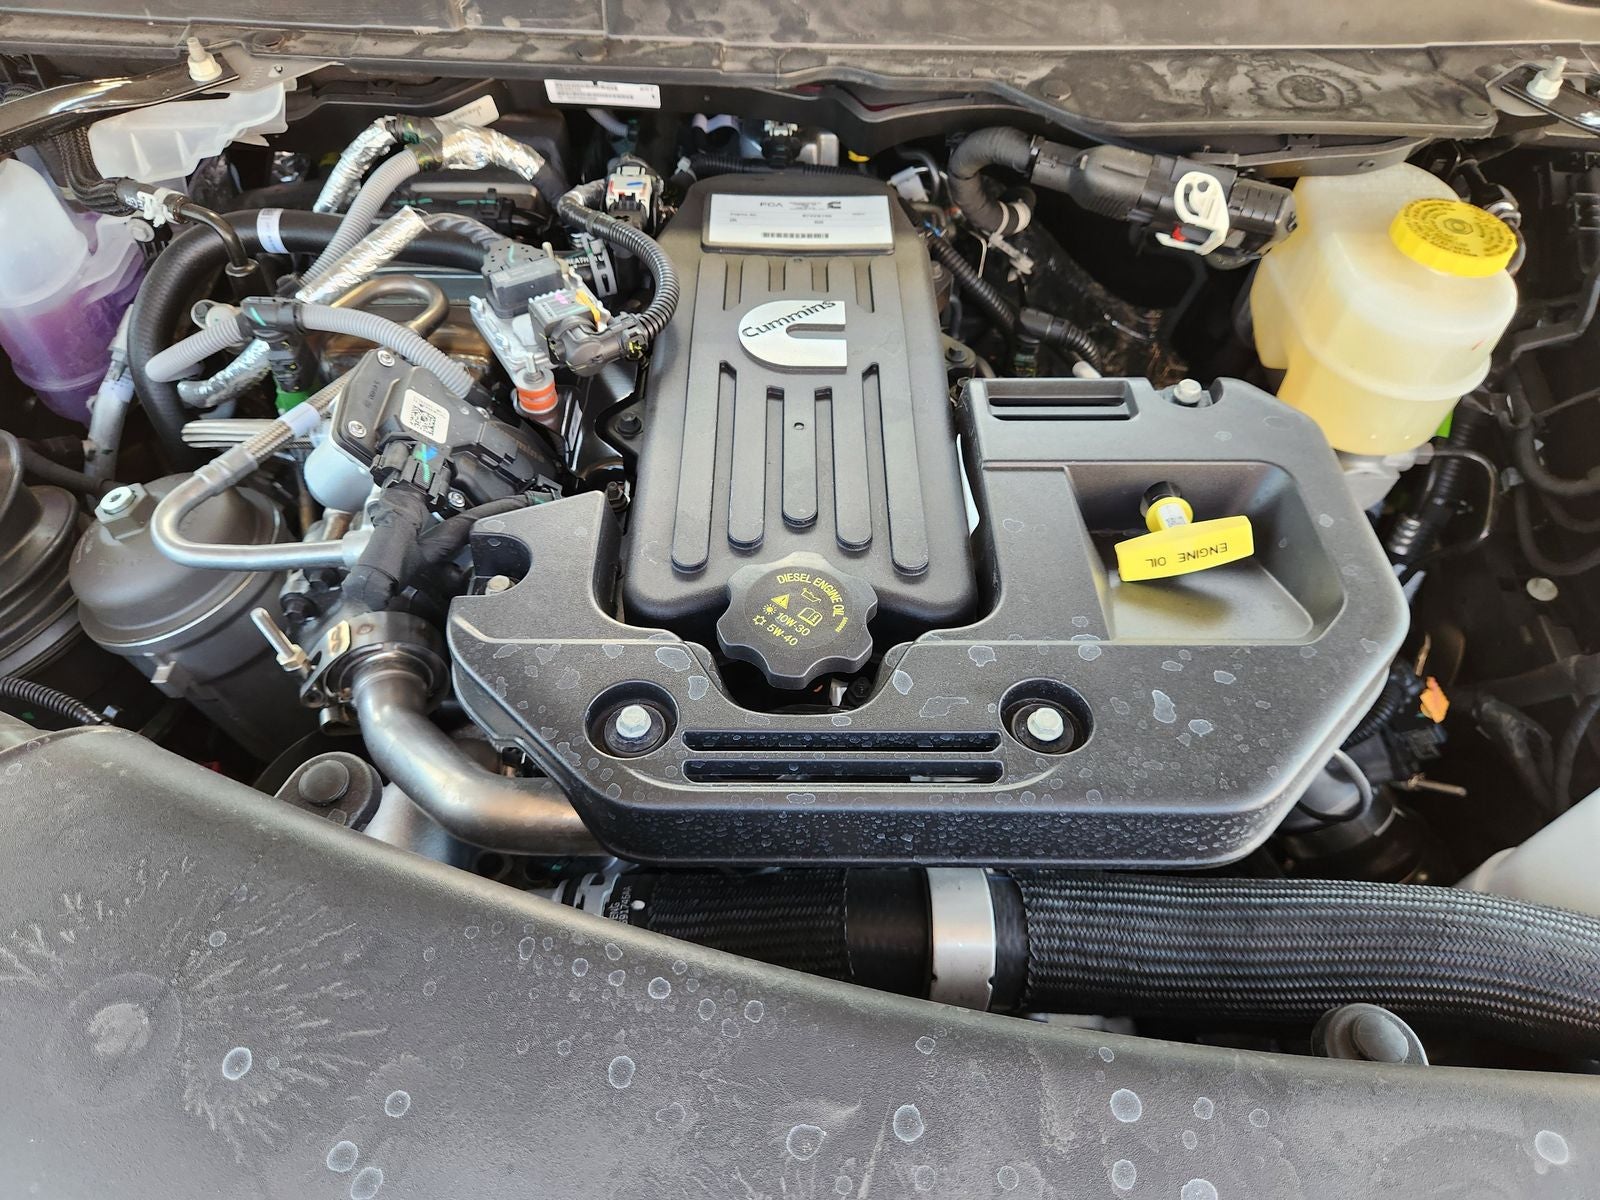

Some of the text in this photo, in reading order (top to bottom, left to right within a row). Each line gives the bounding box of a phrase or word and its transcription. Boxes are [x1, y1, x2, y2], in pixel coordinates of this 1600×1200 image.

[741, 300, 836, 337] Cummins
[1145, 542, 1228, 568] ENGINE OIL
[776, 572, 845, 617] DIESEL ENGINE OIL
[766, 623, 799, 646] 5W-40
[776, 612, 811, 636] 10W-30
